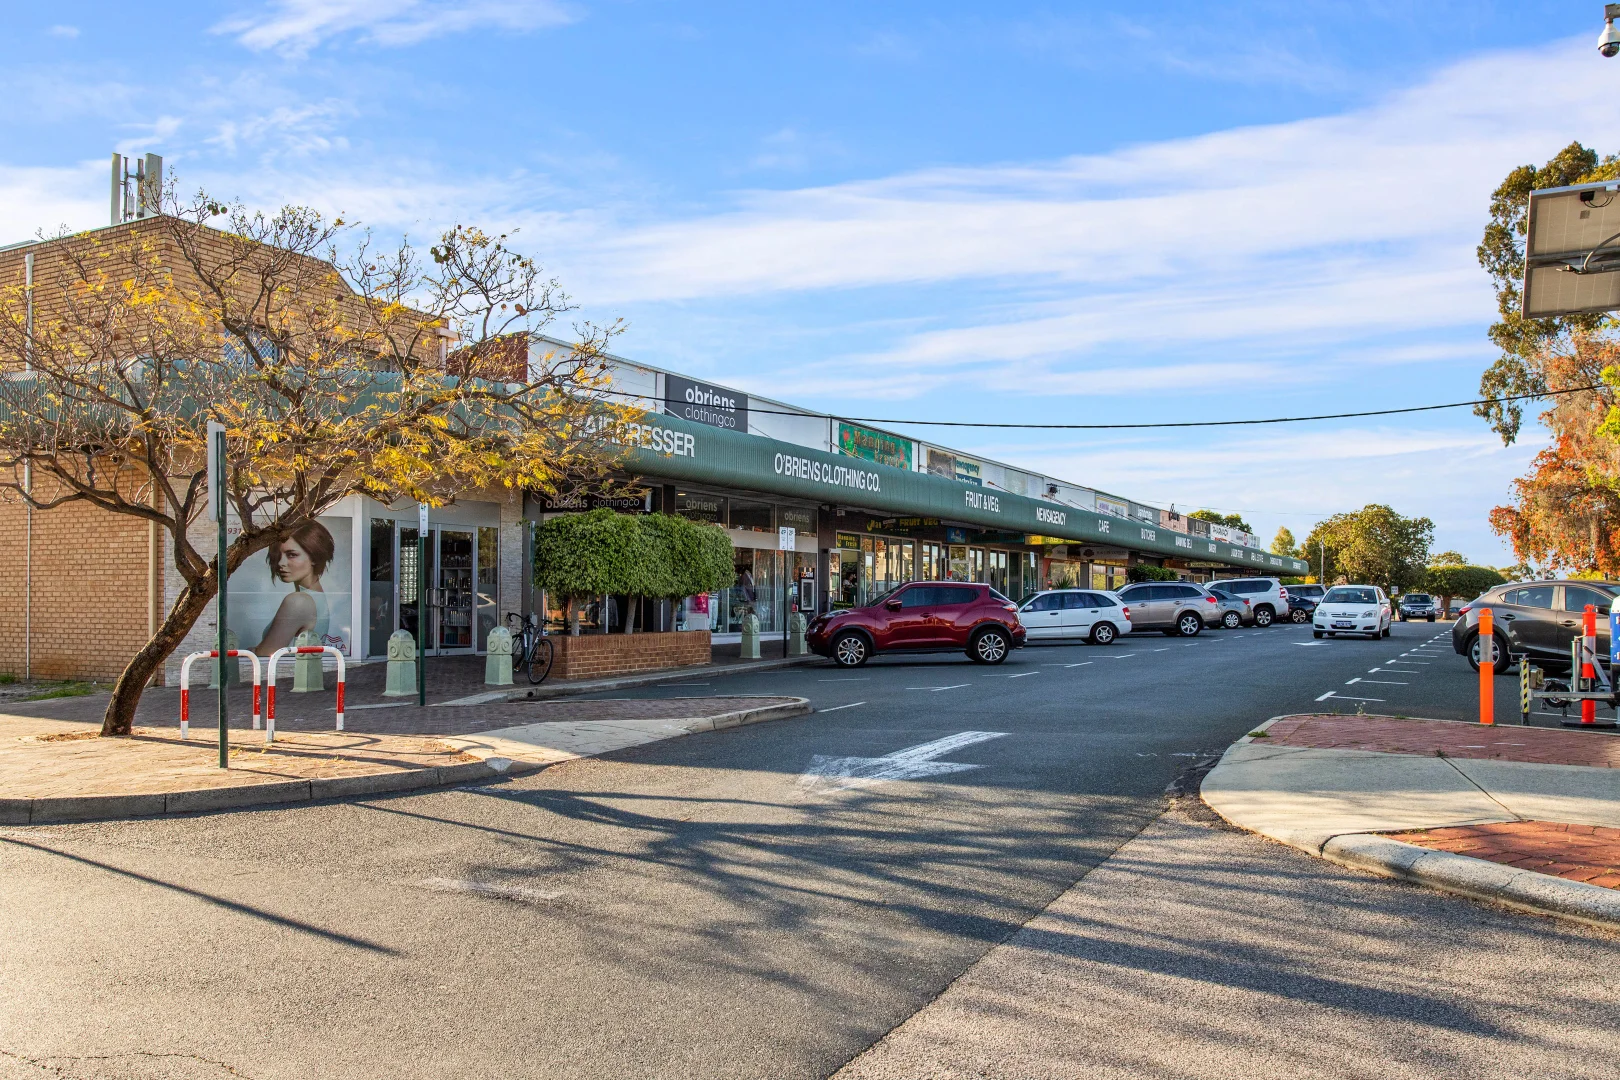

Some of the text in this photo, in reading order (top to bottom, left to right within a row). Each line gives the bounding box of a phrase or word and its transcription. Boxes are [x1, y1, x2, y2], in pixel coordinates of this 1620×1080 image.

[685, 385, 736, 413] obriens
[685, 404, 736, 428] clothingco
[774, 452, 881, 493] O'BRIENS CLOTHING CO.
[592, 497, 641, 508] clothingco
[685, 498, 718, 511] obriens
[965, 490, 982, 509] FRUIT
[784, 510, 810, 523] obriens
[900, 517, 920, 526] FRUIT
[1036, 506, 1067, 526] NEWSAGENCY
[1098, 520, 1110, 534] CAFE
[1141, 528, 1156, 542] BUTCHER
